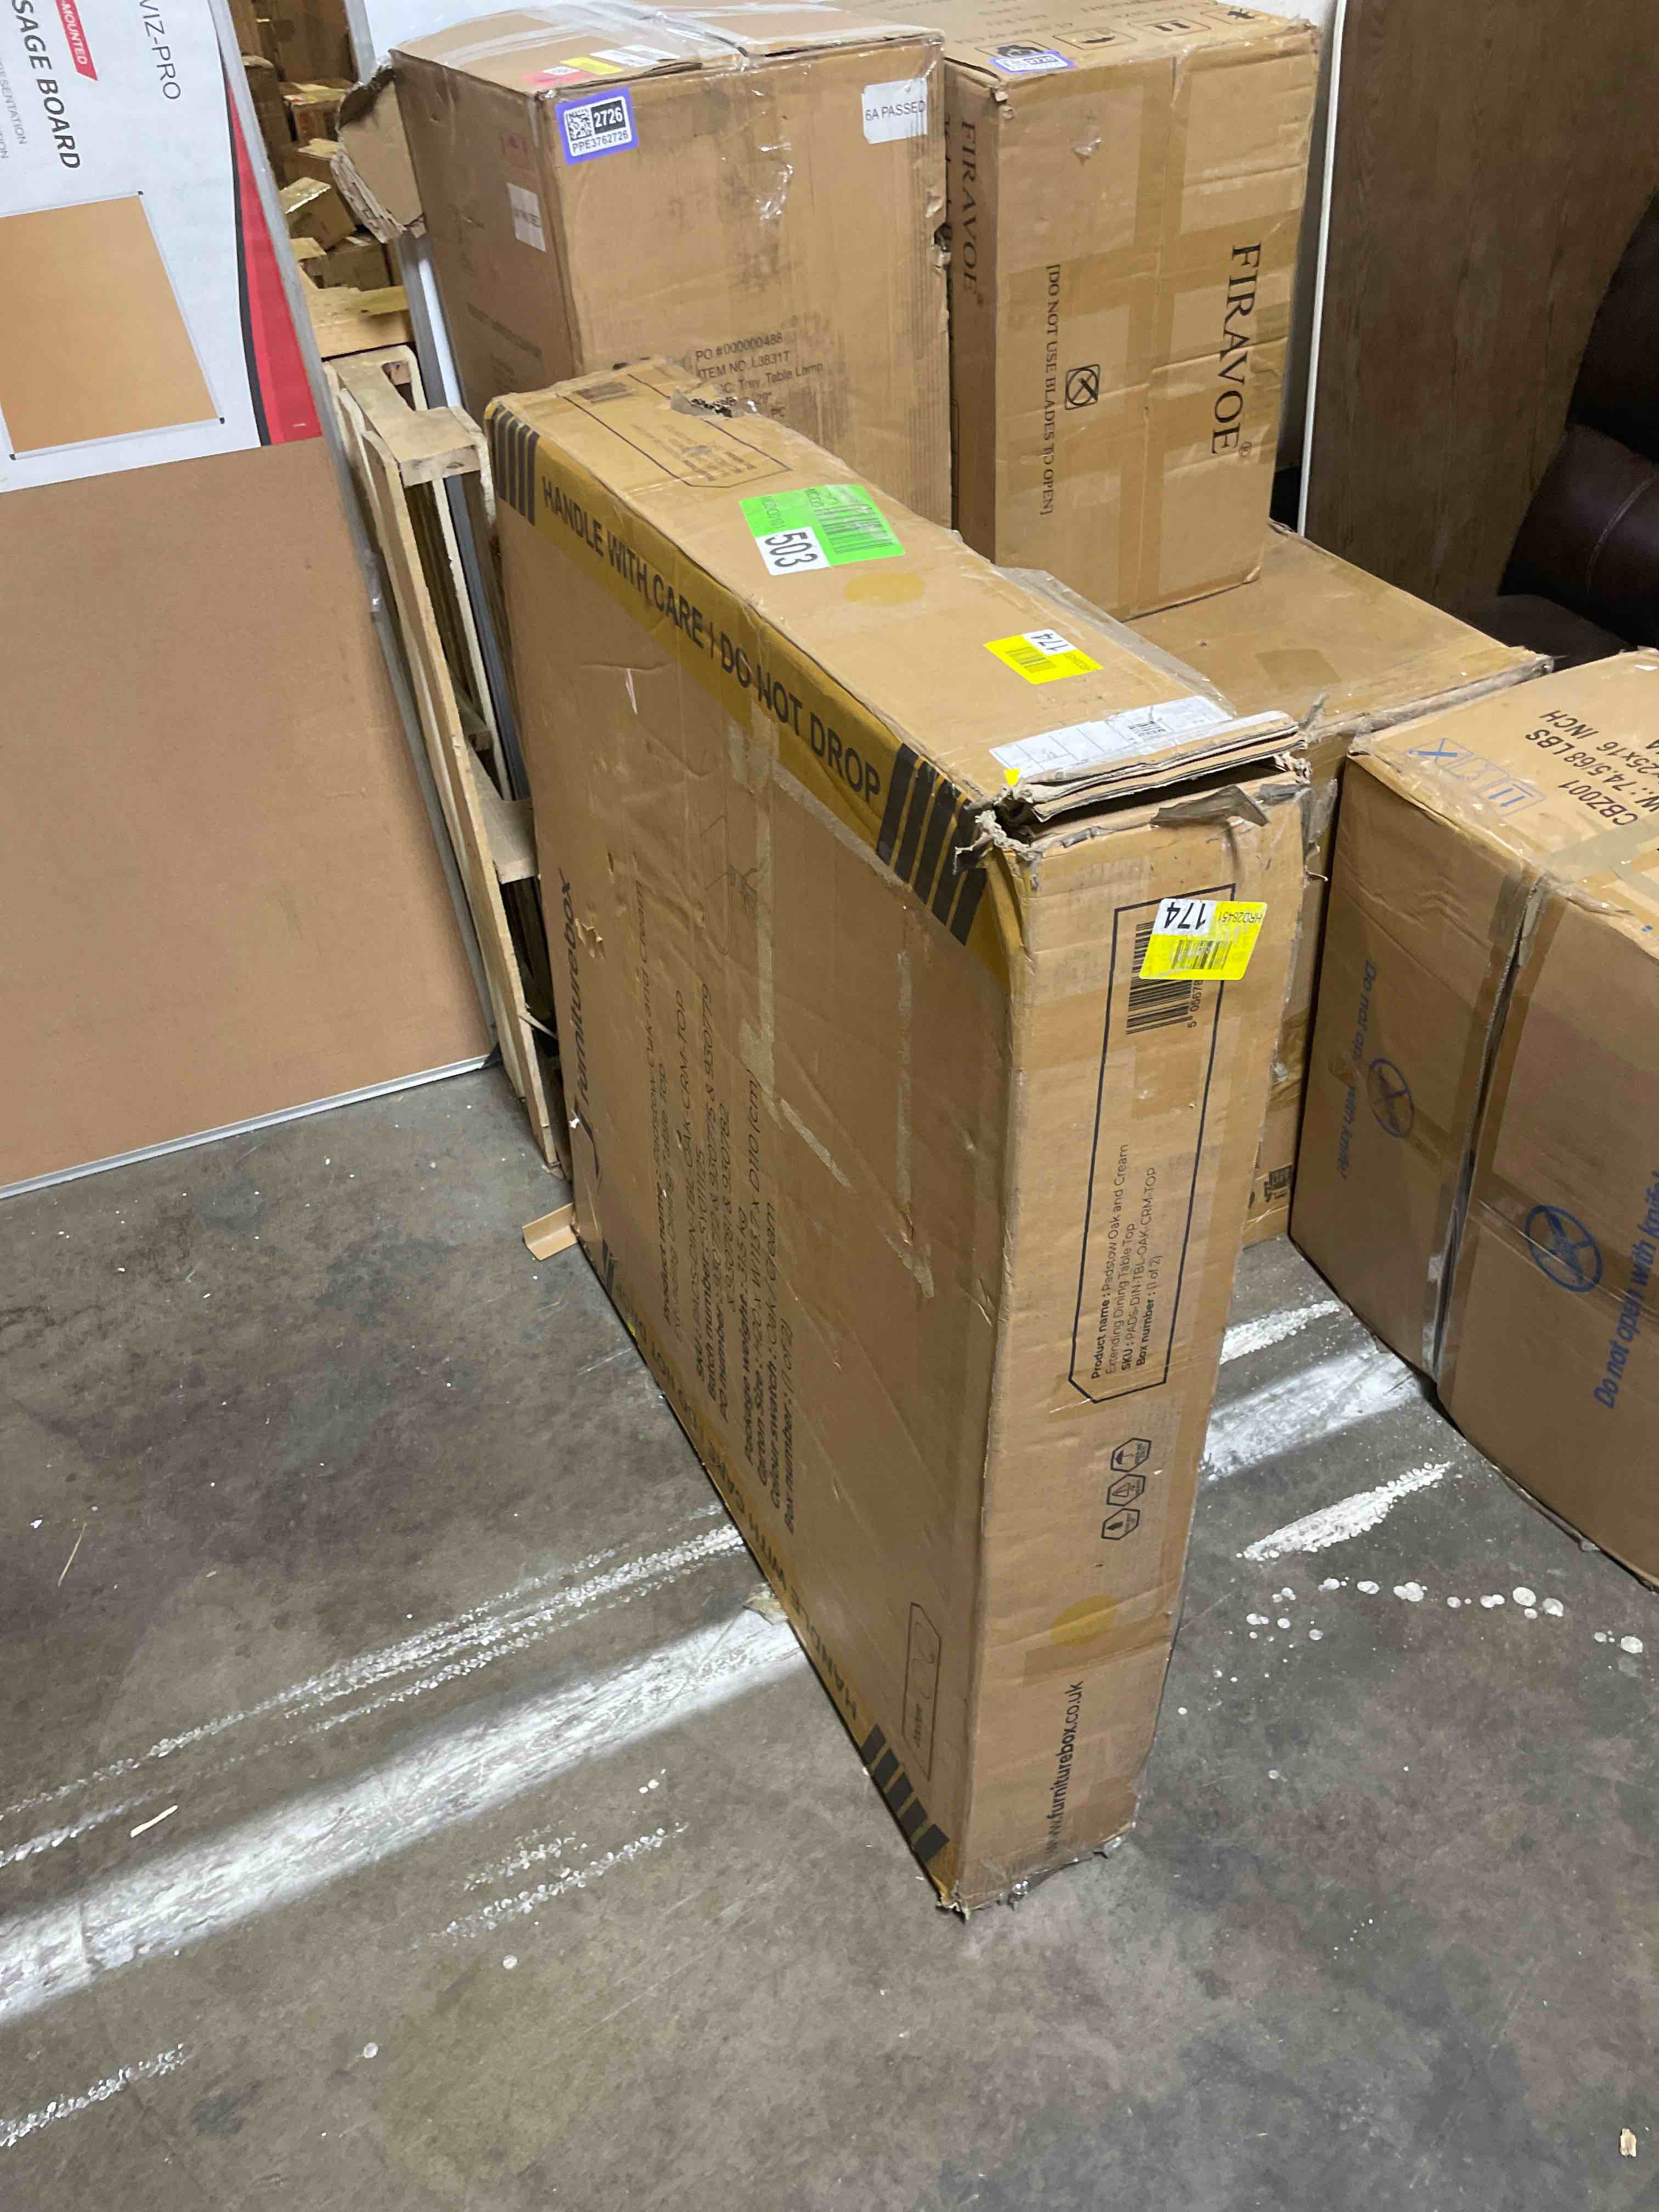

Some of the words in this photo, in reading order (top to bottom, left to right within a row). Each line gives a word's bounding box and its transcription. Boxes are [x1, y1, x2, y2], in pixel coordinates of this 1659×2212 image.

[140, 0, 181, 99] VIZ-PRO
[36, 79, 81, 168] BOARD
[594, 107, 623, 128] 2726
[865, 109, 879, 121] 6A
[882, 100, 926, 117] PASSED
[572, 131, 629, 153] PPE3762726
[1047, 301, 1059, 335] NOT
[1046, 339, 1058, 374] USE
[765, 369, 793, 383] Table
[1044, 376, 1057, 441] BLADES
[764, 531, 819, 568] 503
[541, 476, 605, 560] HANDLE
[606, 532, 648, 592] WITH
[653, 573, 704, 648] CARE
[720, 632, 752, 689] DO
[757, 671, 803, 739] NOT
[809, 710, 882, 803] DROP
[1030, 632, 1070, 652] 174
[1525, 729, 1576, 755] LBS
[1538, 710, 1600, 740] INCH
[1558, 780, 1639, 826] CBZ001
[1163, 901, 1207, 930] 174
[1115, 1144, 1128, 1184] Cream
[1114, 1188, 1123, 1212] and
[1108, 1215, 1120, 1240] Oak
[1122, 1223, 1136, 1246] Top
[1101, 1243, 1118, 1292] Padstow
[1118, 1248, 1132, 1279] Table
[1629, 1239, 1657, 1286] with
[702, 1255, 712, 1338] number
[1099, 1300, 1111, 1330] name
[1114, 1278, 1128, 1318] Dining
[1136, 1345, 1146, 1365] Box
[1141, 1299, 1154, 1342] number
[1617, 1289, 1644, 1342] open
[716, 1306, 725, 1386] number
[1092, 1332, 1105, 1379] Product
[1121, 1349, 1133, 1371] SKU
[1606, 1339, 1629, 1379] not
[768, 1359, 776, 1438] swatch
[1594, 1376, 1619, 1409] Do
[783, 1402, 791, 1490] number
